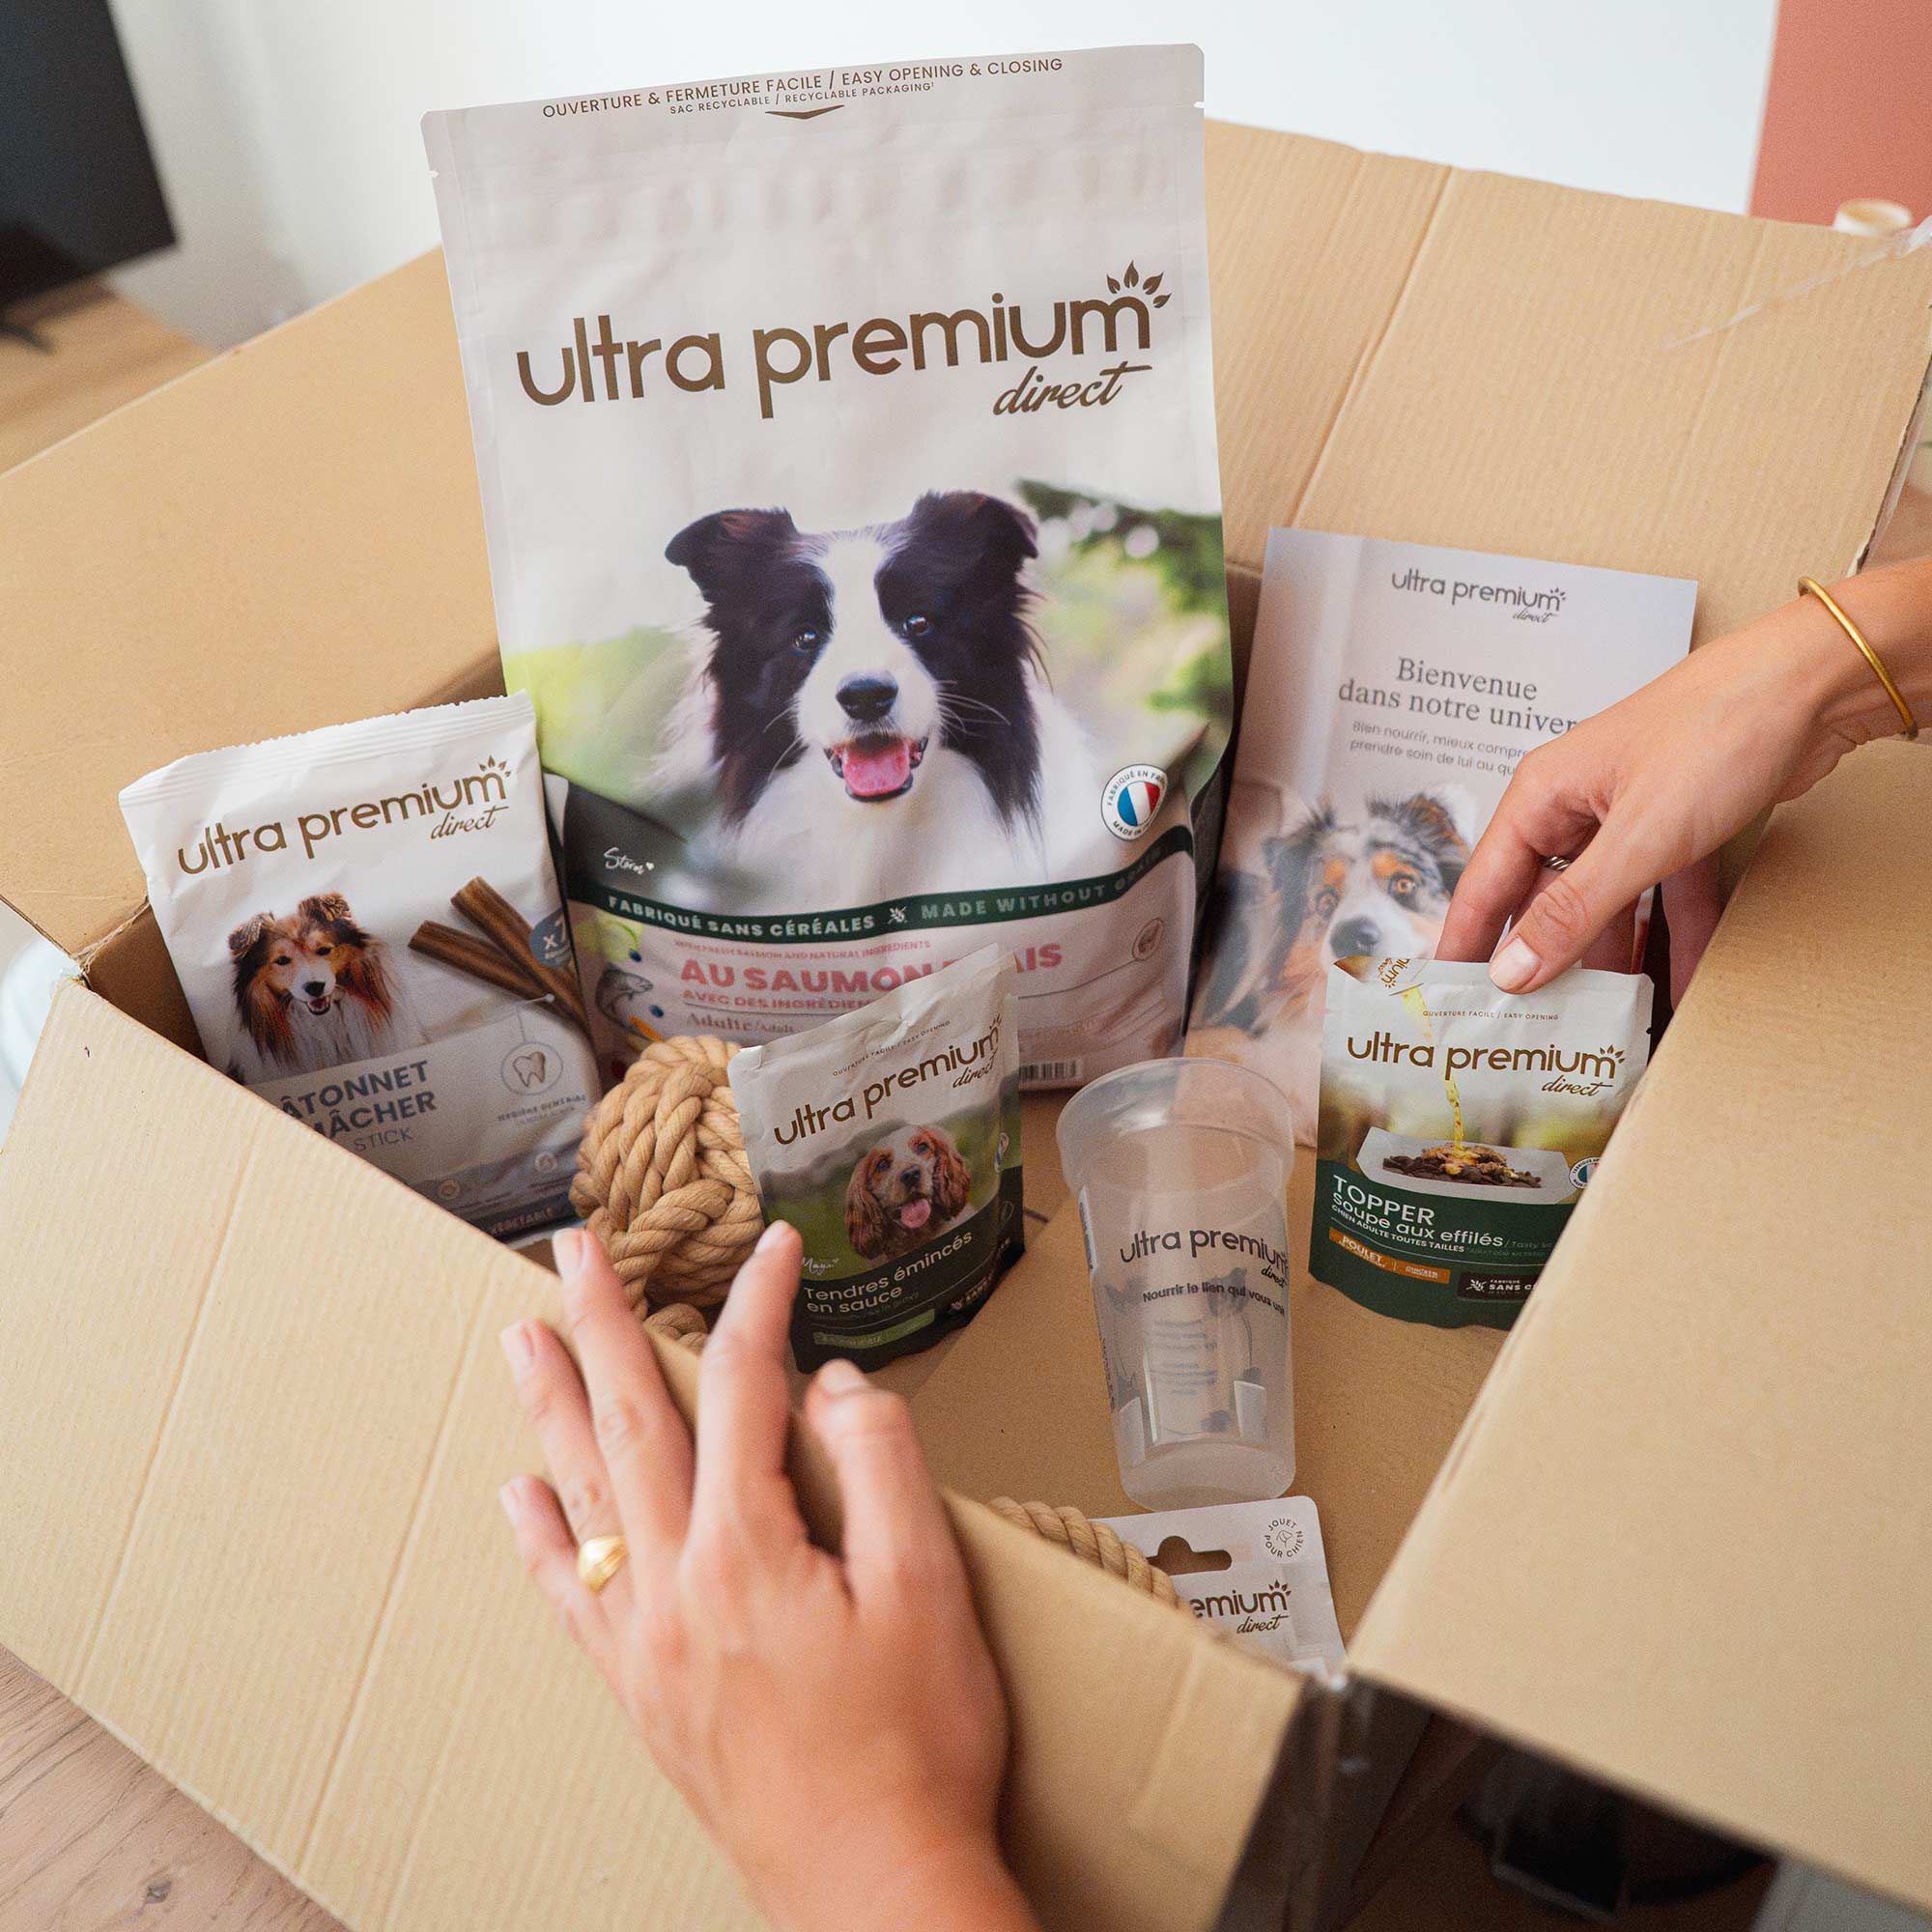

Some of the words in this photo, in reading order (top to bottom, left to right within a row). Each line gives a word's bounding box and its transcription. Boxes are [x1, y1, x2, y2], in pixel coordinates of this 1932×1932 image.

[542, 93, 642, 118] OUVERTURE
[647, 92, 661, 104] &
[666, 80, 761, 103] FERMETURE
[766, 74, 822, 92] FACILE
[841, 70, 883, 87] EASY
[889, 63, 964, 82] OPENING
[969, 63, 981, 76] &
[987, 58, 1063, 75] CLOSING
[669, 103, 694, 115] SAC
[698, 96, 771, 112] RECYCLABLE
[784, 88, 858, 102] RECYCLABLE
[515, 314, 724, 407] ultra
[753, 292, 1151, 419] premium
[992, 361, 1152, 416] direct
[1390, 567, 1446, 596] ultra
[1451, 580, 1561, 611] premium
[1511, 608, 1559, 624] direct
[1397, 657, 1538, 701] Bienvenue
[1338, 678, 1402, 708] dans
[1408, 693, 1481, 722] notre
[1490, 706, 1577, 735] univer
[1352, 720, 1381, 736] Bien
[1383, 725, 1431, 745] nourrir,
[1433, 733, 1475, 751] mieux
[1350, 738, 1404, 756] prendre
[1406, 745, 1434, 761] soin
[1436, 749, 1454, 765] de
[1457, 753, 1473, 768] lui
[1496, 762, 1516, 777] qu
[177, 820, 288, 875] ultra
[298, 771, 507, 859] premium
[430, 805, 510, 840] direct
[607, 895, 702, 929] FABRIQUÉ
[707, 919, 763, 936] SANS
[769, 916, 875, 937] CÉRÉALES
[921, 899, 987, 919] MADE
[996, 884, 1107, 913] WITHOUT
[680, 957, 734, 988] AU
[682, 989, 731, 1006] AVEC
[921, 1019, 952, 1037] OPENING
[1347, 1030, 1435, 1068] ultra
[1443, 1043, 1617, 1082] premium
[280, 1060, 428, 1120] ÂTONNET
[773, 1095, 856, 1146] ultra
[863, 1026, 1000, 1120] premium
[1541, 1075, 1616, 1097] direct
[353, 1126, 413, 1152] STICK
[1332, 1192, 1391, 1229] Soupe
[1396, 1222, 1435, 1239] aux
[1440, 1229, 1504, 1247] effilés
[1333, 1174, 1435, 1226] TOPPER
[1331, 1205, 1355, 1224] CHIEN
[1356, 1220, 1390, 1238] ADULTE
[1391, 1233, 1428, 1247] TOUTES
[1429, 1242, 1464, 1253] TAILLES
[804, 1276, 890, 1301] Tendres
[894, 1231, 973, 1282] émincés
[1120, 1230, 1182, 1264] ultra
[1189, 1229, 1288, 1274] premium
[1143, 1284, 1184, 1303] Nourrir
[1187, 1282, 1199, 1293] le
[1201, 1281, 1225, 1293] lien
[1228, 1285, 1246, 1297] qui
[1249, 1289, 1271, 1306] vous
[1261, 1264, 1288, 1289] direct
[807, 1301, 834, 1314] en
[838, 1286, 903, 1314] sauce
[1264, 1534, 1283, 1558] POUR
[1286, 1530, 1304, 1558] CHIEN
[1268, 1518, 1297, 1532] JOUET
[1189, 1590, 1288, 1619] emium
[1236, 1615, 1290, 1634] direct
